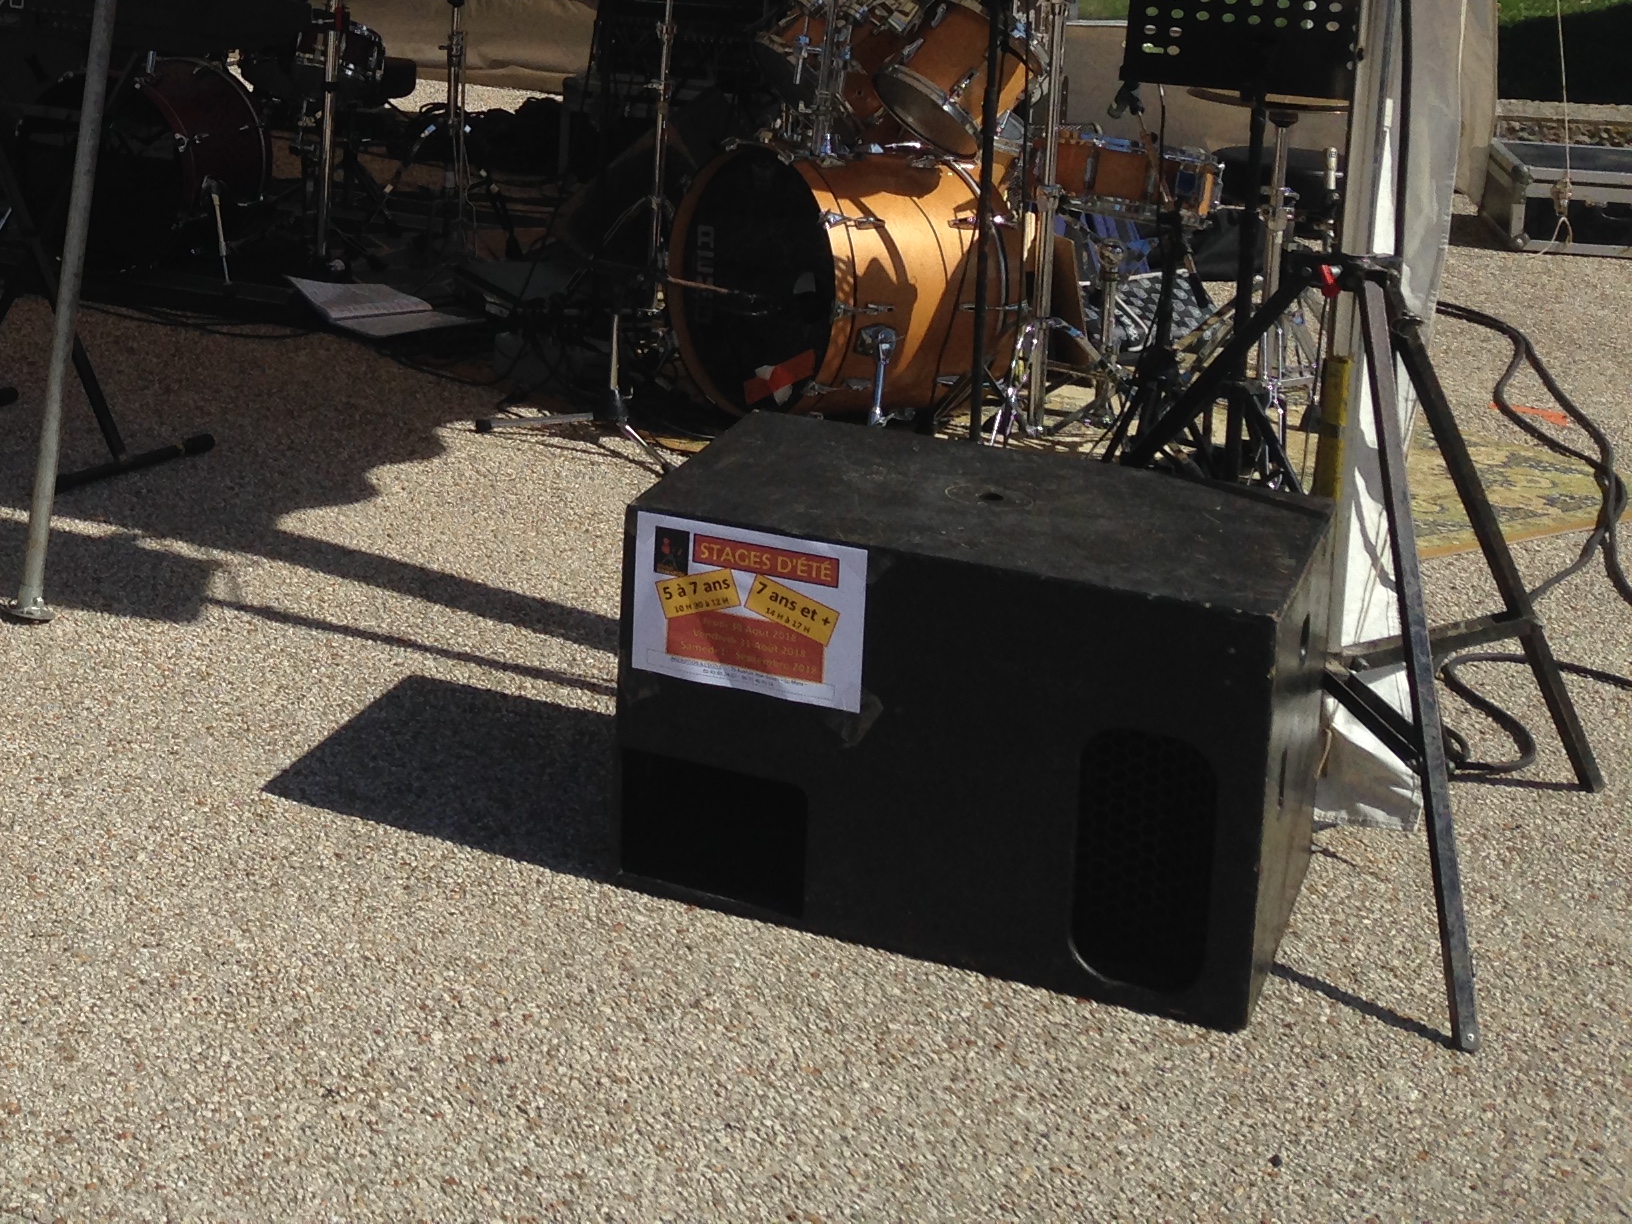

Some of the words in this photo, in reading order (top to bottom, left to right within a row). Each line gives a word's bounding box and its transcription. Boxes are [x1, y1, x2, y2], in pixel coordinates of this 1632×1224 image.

[700, 542, 771, 570] STAGES
[777, 556, 832, 581] D'ÉTÉ
[662, 586, 673, 601] 5
[677, 583, 687, 598] à
[689, 581, 698, 596] 7
[703, 578, 731, 593] ans
[674, 605, 685, 613] 10
[711, 597, 721, 606] 12
[756, 581, 768, 594] 7
[769, 591, 798, 611] ans
[800, 606, 818, 622] et
[821, 616, 831, 626] +
[765, 607, 775, 616] 14
[792, 620, 802, 629] 17
[772, 630, 797, 642] 2018
[782, 646, 807, 658] 2018
[792, 661, 817, 674] 2018
